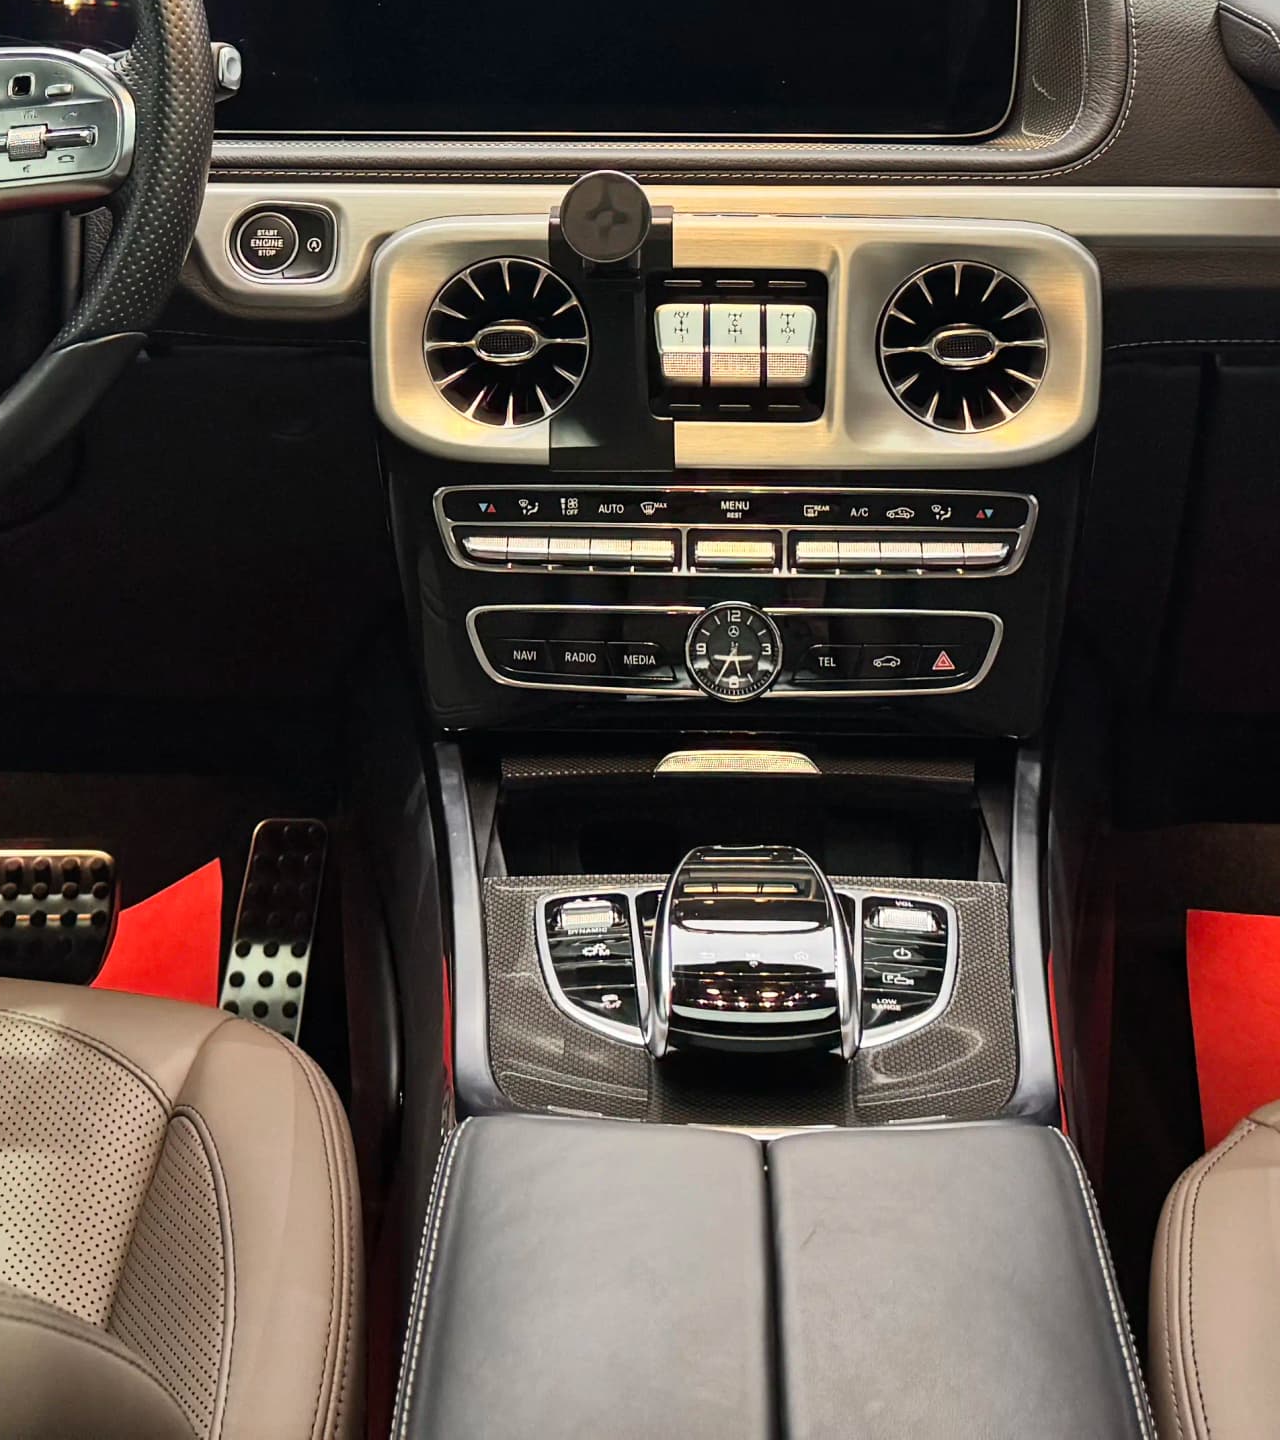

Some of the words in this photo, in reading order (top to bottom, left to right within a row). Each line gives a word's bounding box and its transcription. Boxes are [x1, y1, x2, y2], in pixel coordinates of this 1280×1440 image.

[250, 239, 284, 248] ENGINE
[598, 503, 625, 514] AUTO
[720, 500, 750, 511] MENU
[726, 511, 742, 519] REST
[850, 507, 869, 518] A/C
[727, 610, 741, 622] 12
[696, 643, 707, 655] 9
[761, 643, 772, 655] 3
[513, 650, 537, 661] NAVI
[564, 651, 597, 663] RADIO
[623, 654, 656, 666] MEDIA
[818, 657, 837, 667] TEL
[567, 926, 608, 936] DYNAMIC
[871, 1003, 902, 1012] RANGE
